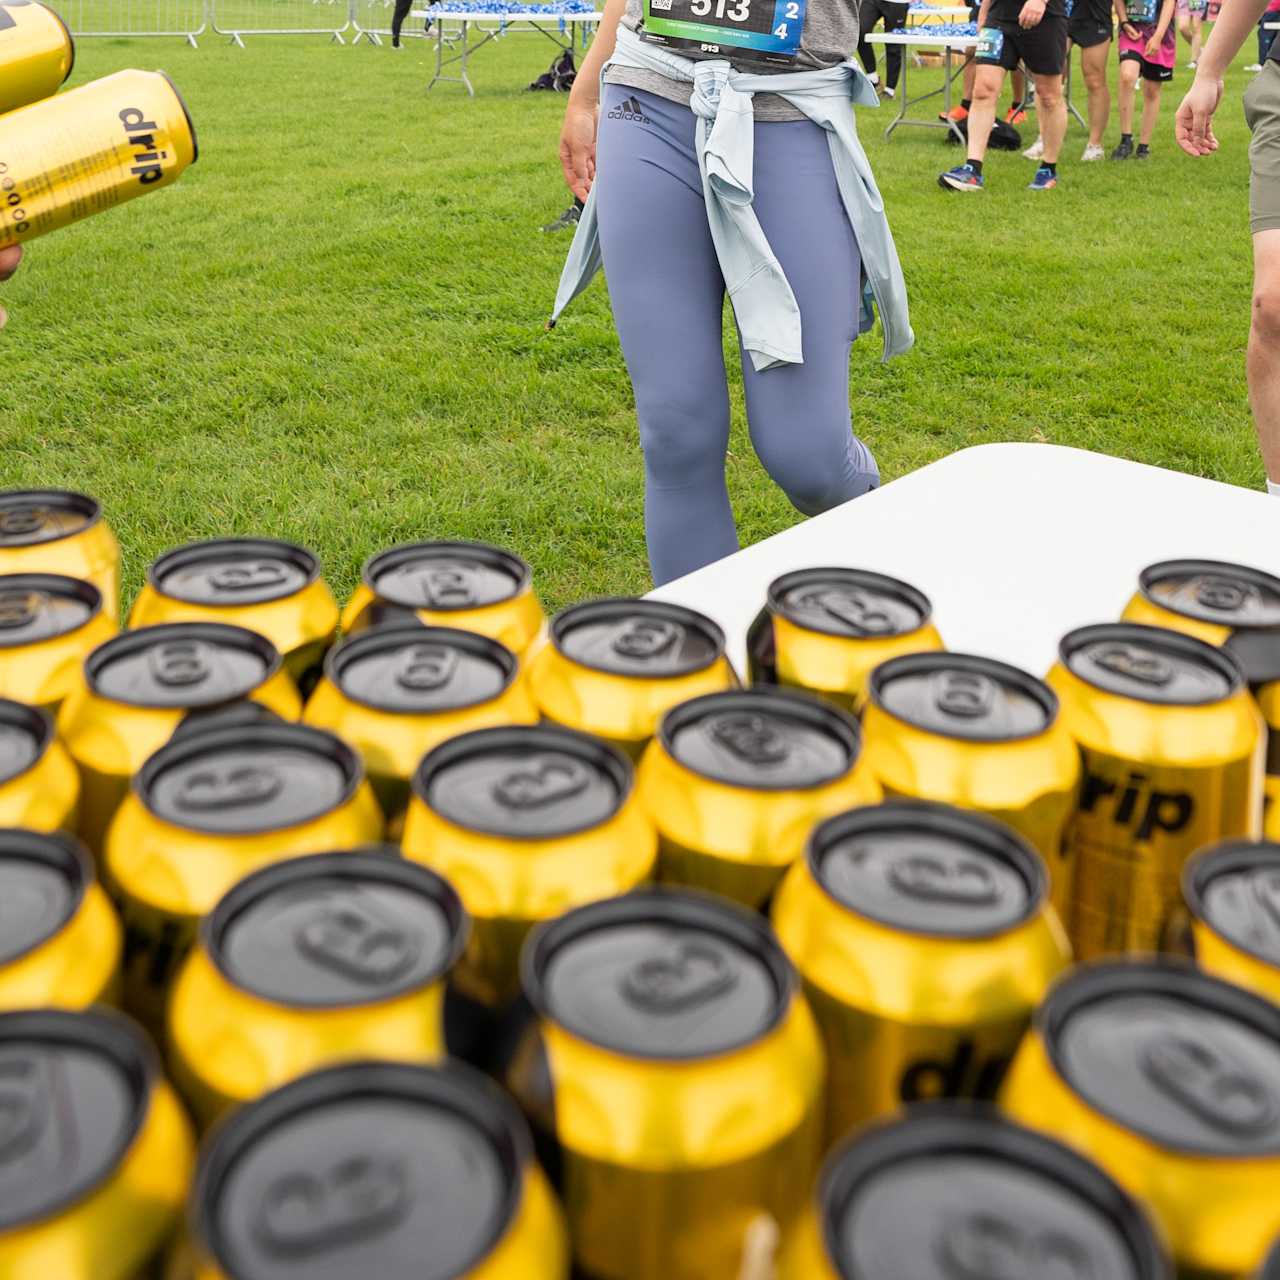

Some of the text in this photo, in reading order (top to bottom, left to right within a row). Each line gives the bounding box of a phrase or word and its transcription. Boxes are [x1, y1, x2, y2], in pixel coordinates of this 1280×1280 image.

[700, 43, 720, 53] 513
[119, 108, 167, 185] drip
[1076, 772, 1194, 843] rip
